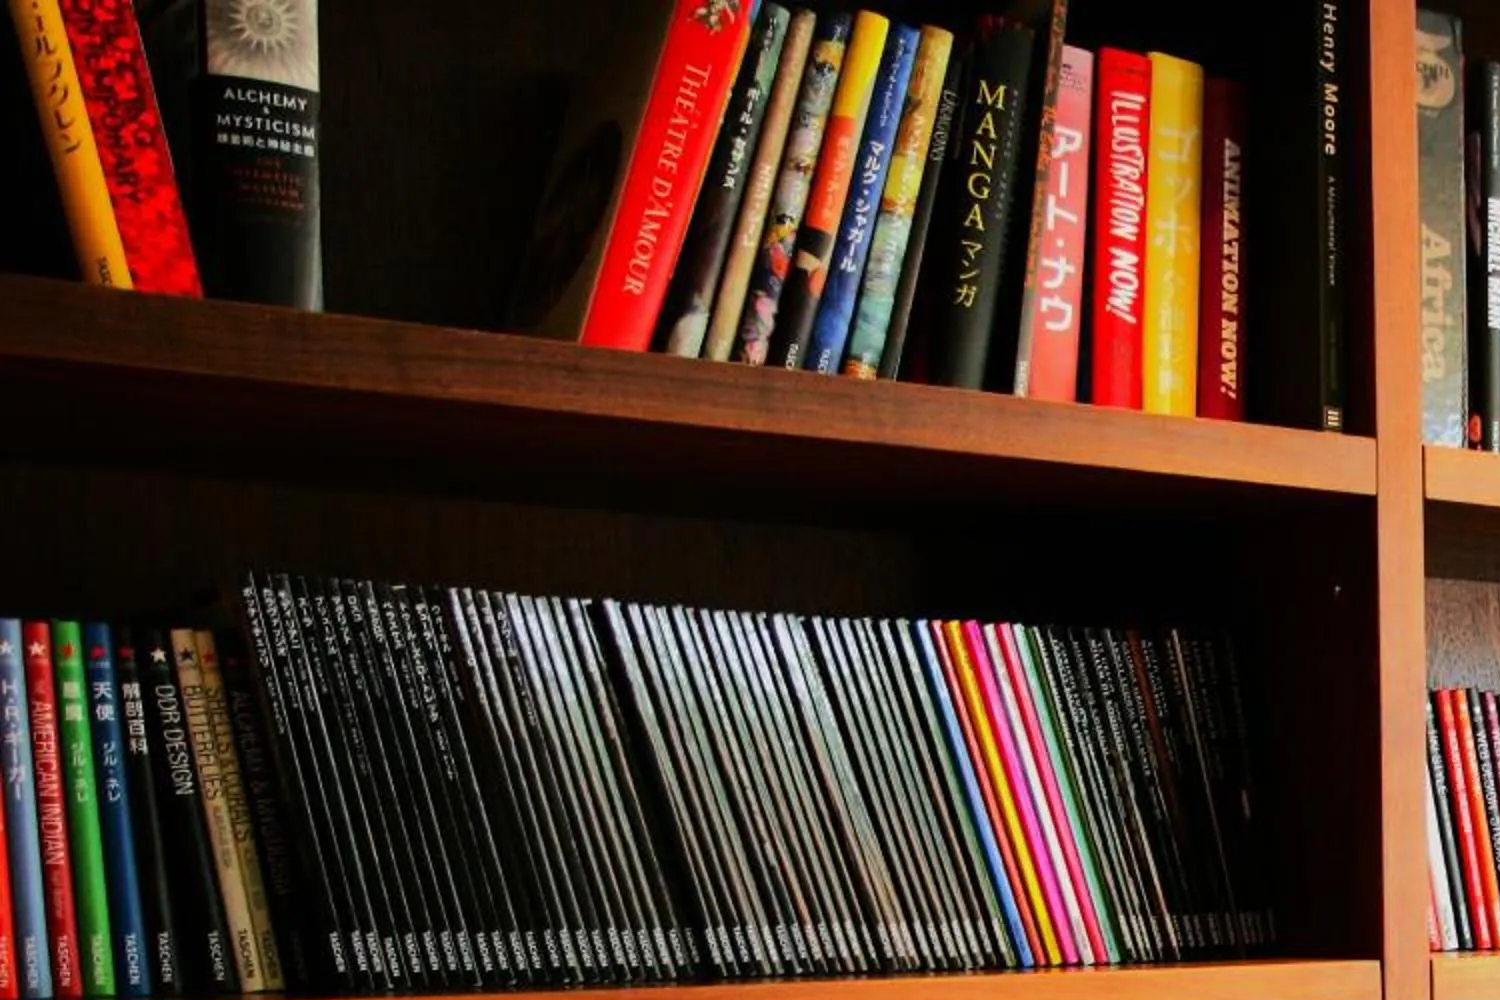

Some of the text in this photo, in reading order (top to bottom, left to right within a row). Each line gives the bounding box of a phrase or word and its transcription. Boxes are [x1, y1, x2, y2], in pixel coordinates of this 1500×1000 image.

[223, 87, 308, 111] ALCHEMY
[1322, 2, 1340, 156] Henry Moore
[217, 114, 315, 140] MYSTICISM
[964, 80, 1005, 232] MANGA
[621, 180, 675, 296] D'AMOUR
[1040, 126, 1083, 332] アート・ナウ
[1105, 91, 1146, 325] ILLUSTRATION NOW!
[953, 238, 984, 308] マンガ
[1220, 138, 1243, 400] ANIMATION NOW!
[1421, 222, 1452, 383] Africa
[93, 681, 116, 723] 天使
[122, 682, 149, 756] 解剖百科
[154, 684, 196, 798] DDR DESIGN
[183, 685, 223, 802] BUTTERFLIES
[32, 700, 65, 866] AMERICAN INDIAN
[56, 935, 72, 988] TASCHEN
[125, 934, 141, 987] TASCHEN
[158, 933, 172, 984] TASCHEN
[207, 929, 226, 983] TASCHEN
[237, 927, 256, 982] TASCHEN
